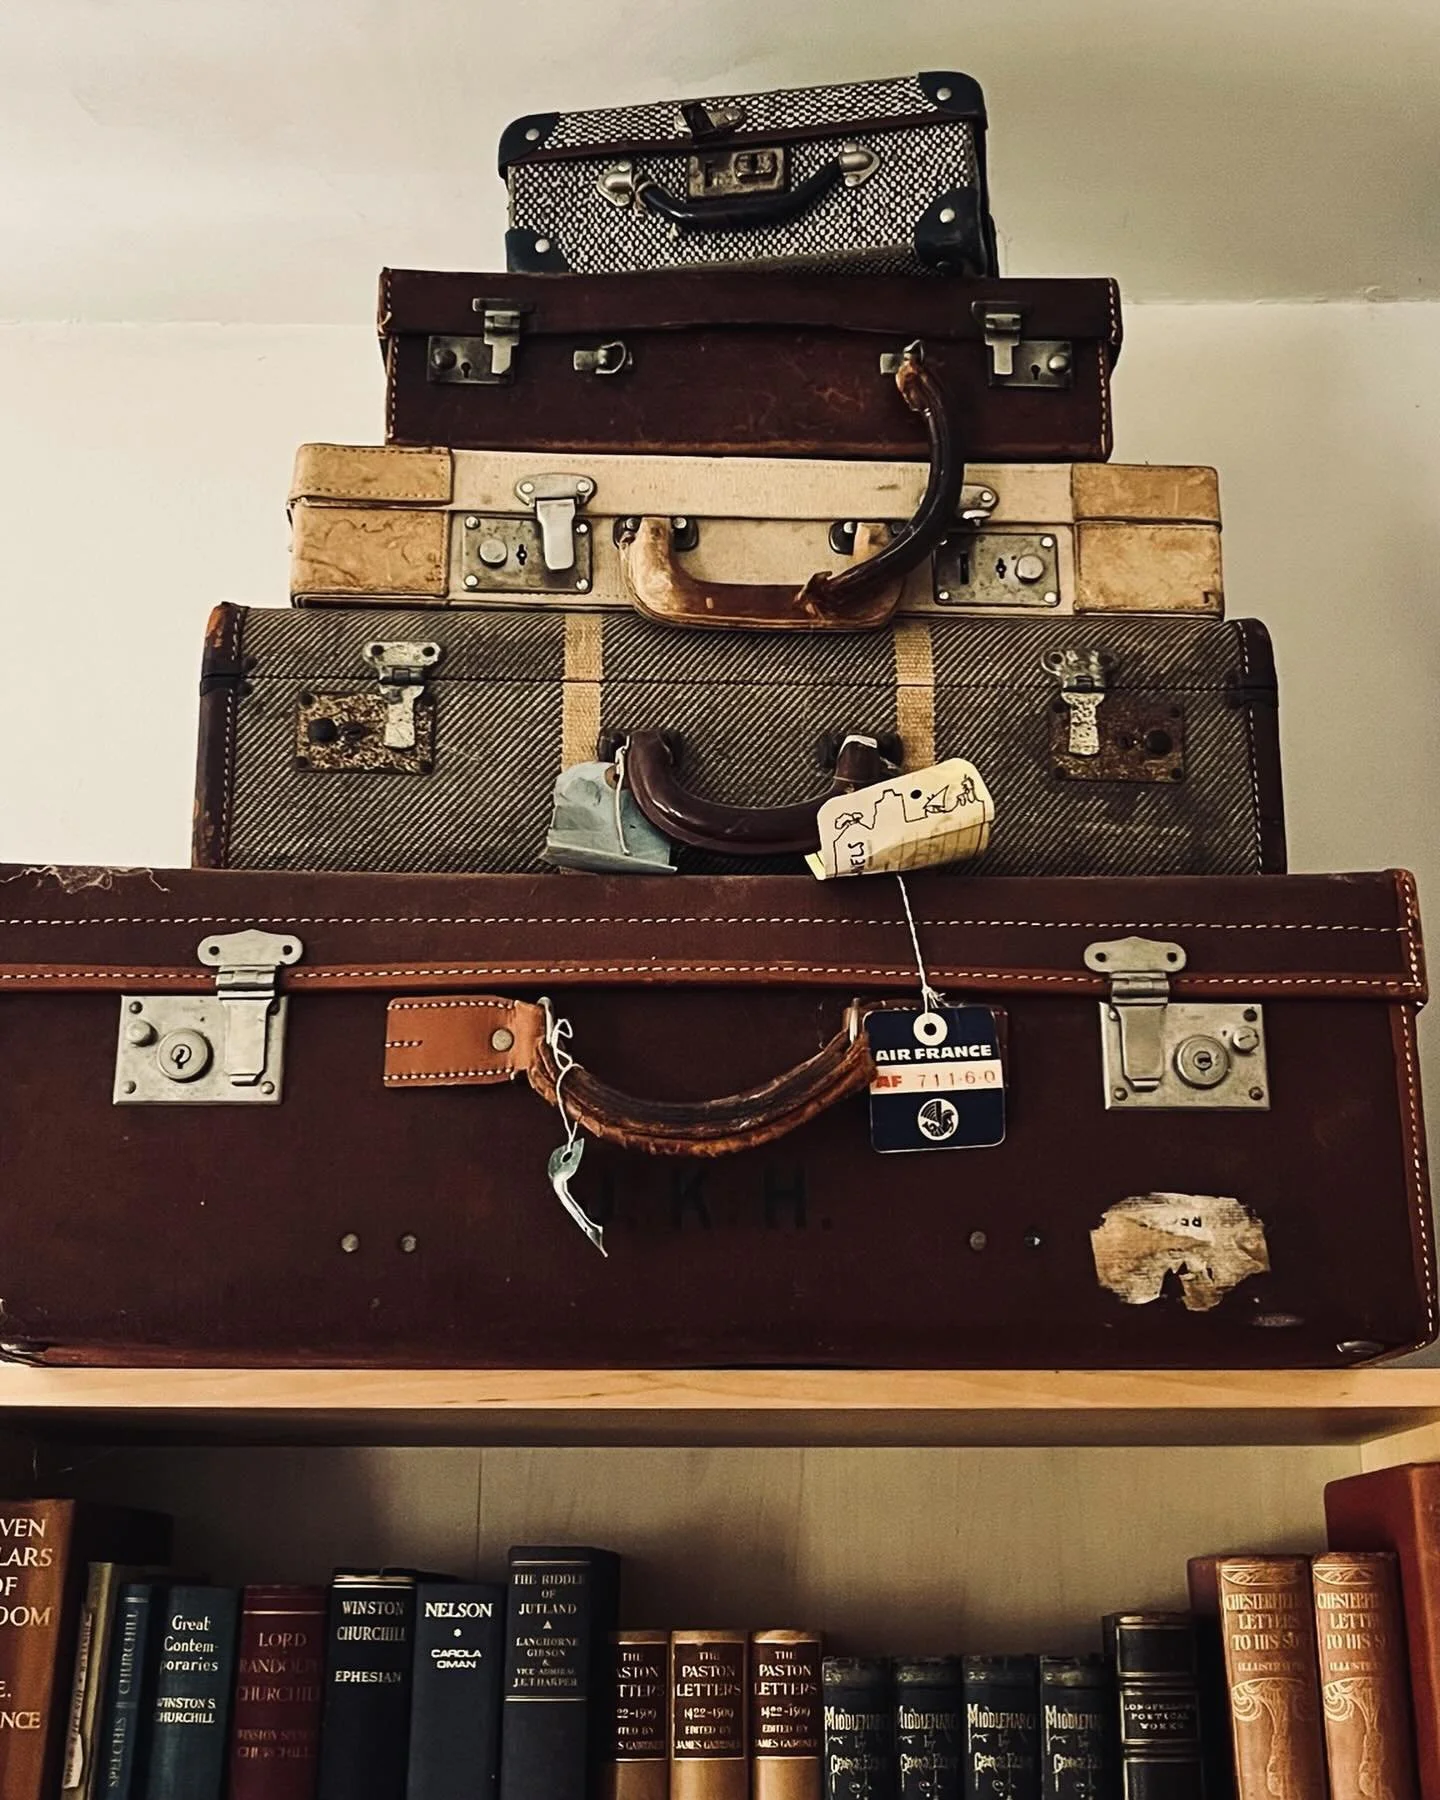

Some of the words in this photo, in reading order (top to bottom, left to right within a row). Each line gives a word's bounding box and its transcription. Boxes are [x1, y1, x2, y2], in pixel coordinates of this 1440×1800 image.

[847, 841, 866, 873] ELS
[876, 1048, 911, 1061] AIR
[915, 1045, 992, 1059] FRANCE
[876, 1075, 902, 1088] AF
[513, 1573, 536, 1585] THE
[541, 1573, 585, 1585] RIDDLE
[0, 1577, 18, 1597] F
[541, 1589, 556, 1599] OF
[342, 1600, 404, 1615] WINSTON
[425, 1602, 494, 1618] NELSON
[518, 1602, 577, 1615] JUTLAND
[172, 1614, 211, 1631] Great
[258, 1632, 307, 1648] LORD
[336, 1626, 405, 1642] CHURCHILL
[1326, 1633, 1342, 1650] TO
[1346, 1633, 1369, 1650] HIS
[164, 1635, 219, 1653] Contem-
[1232, 1634, 1251, 1650] TO
[1254, 1634, 1279, 1650] HIS
[431, 1649, 482, 1658] CAROLA
[160, 1656, 219, 1674] poraries
[436, 1660, 476, 1669] OMAN
[682, 1664, 735, 1678] PASTON
[759, 1664, 811, 1677] PASTON
[334, 1671, 401, 1683] EPHESIAN
[616, 1683, 664, 1698] TTERS
[676, 1683, 741, 1697] LETTERS
[754, 1682, 817, 1696] LETTERS
[109, 1717, 126, 1787] SPEECHES
[119, 1609, 139, 1695] CHURCHILL
[1130, 1712, 1189, 1720] POETICAL
[1139, 1722, 1184, 1730] WORKS
